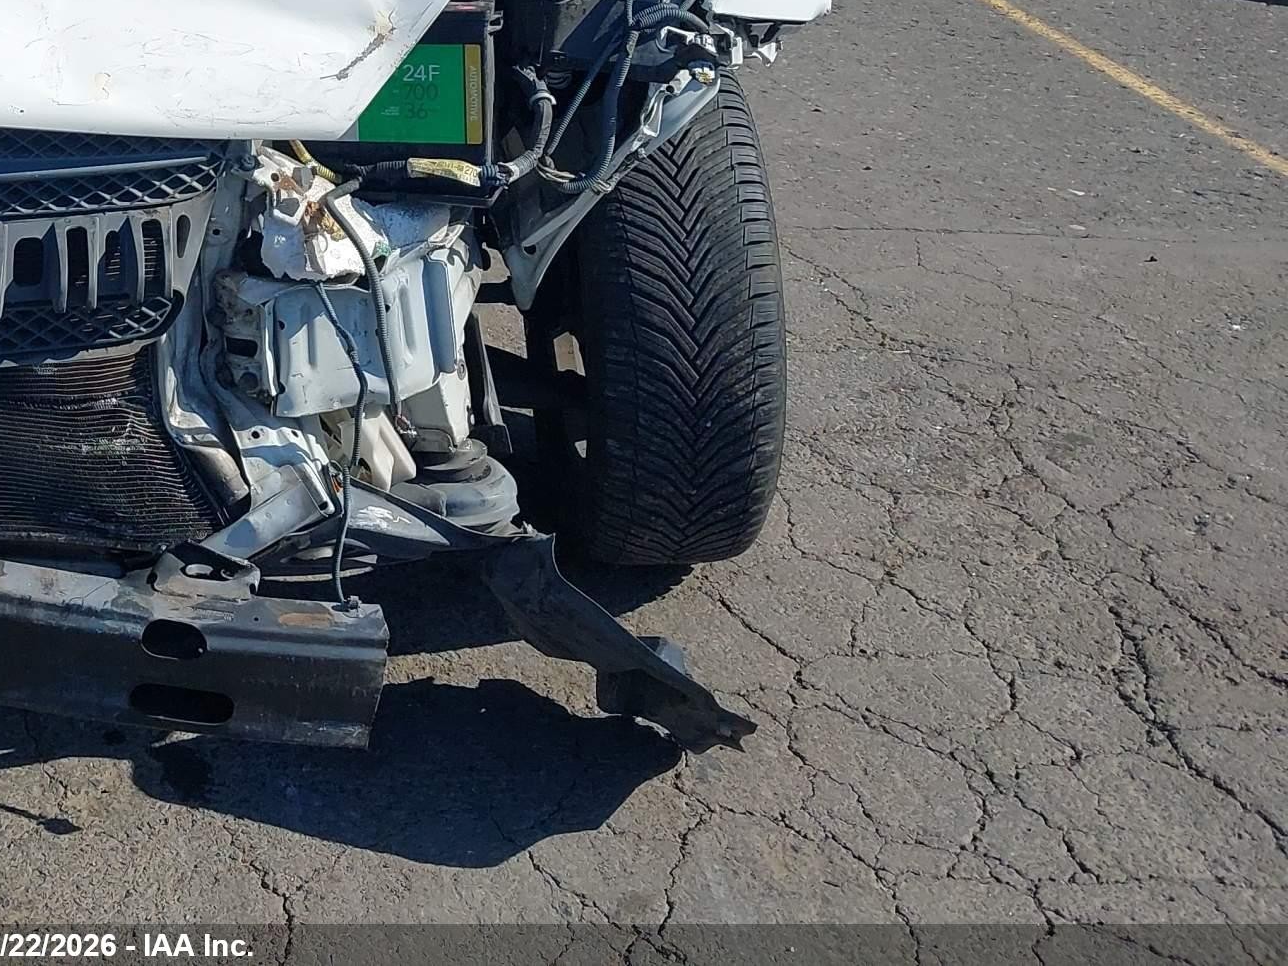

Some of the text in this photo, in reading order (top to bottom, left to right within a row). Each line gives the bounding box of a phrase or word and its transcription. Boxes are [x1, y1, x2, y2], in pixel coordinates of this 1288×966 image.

[402, 64, 441, 82] 24F
[403, 83, 439, 102] 700
[405, 101, 428, 120] 36
